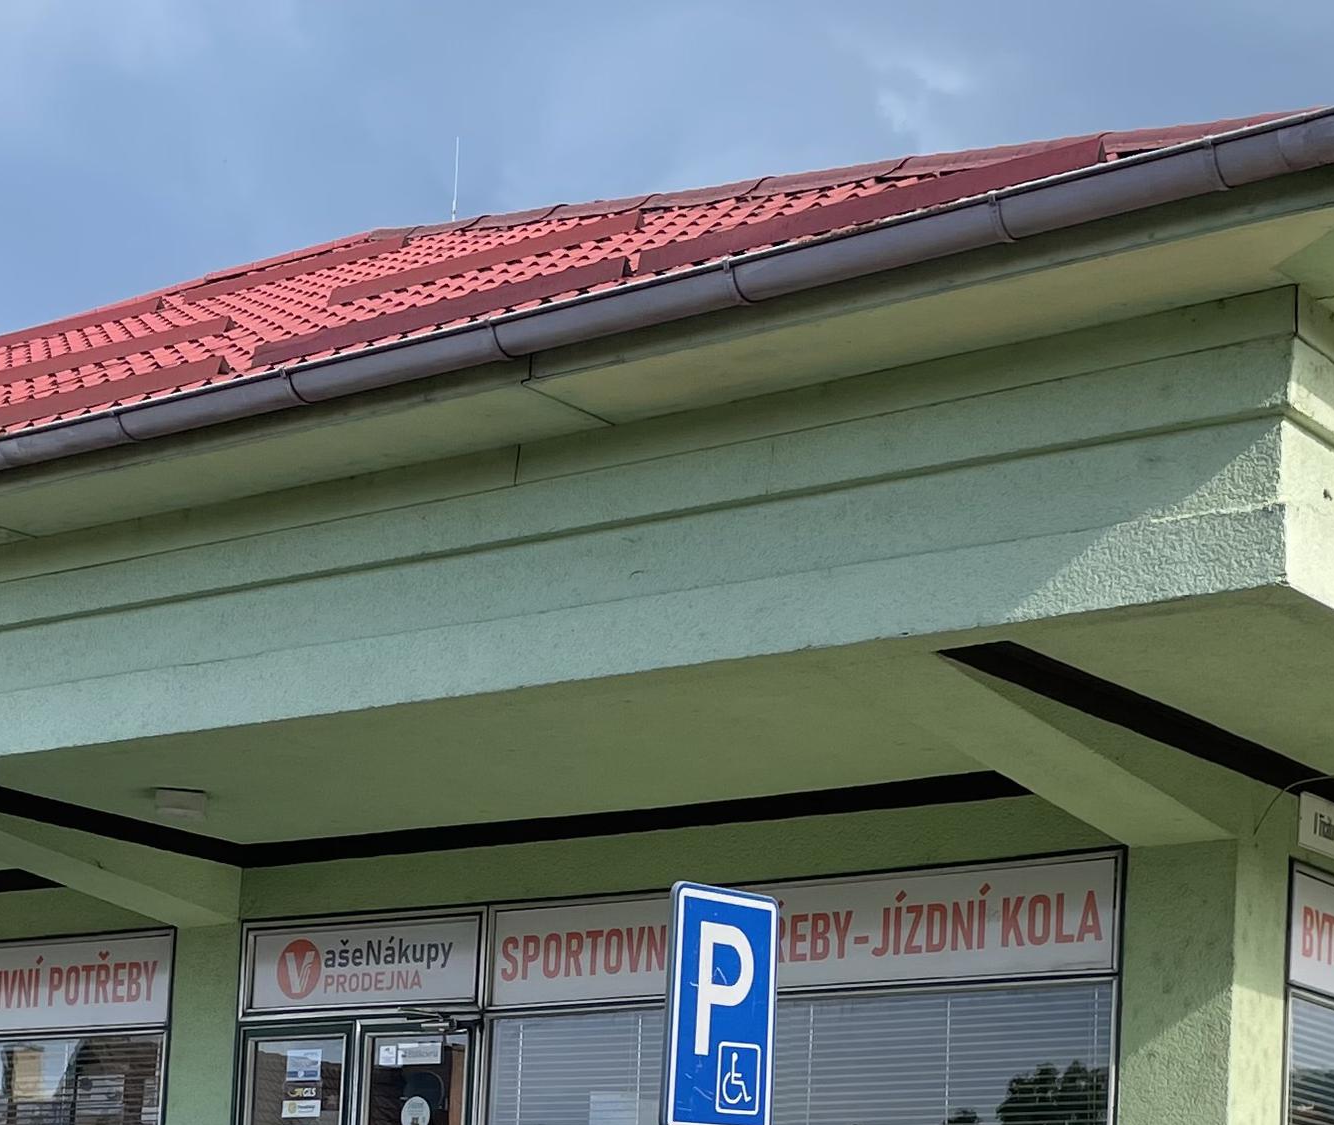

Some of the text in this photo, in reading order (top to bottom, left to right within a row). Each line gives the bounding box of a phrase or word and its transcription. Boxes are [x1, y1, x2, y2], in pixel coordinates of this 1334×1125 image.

[500, 924, 667, 982] SPORTOVN
[1000, 890, 1103, 948] KOLA
[48, 950, 159, 1008] POTŘEBY
[324, 969, 423, 994] PRODEJNA
[694, 920, 755, 1056] P
[302, 1087, 317, 1097] GLS
